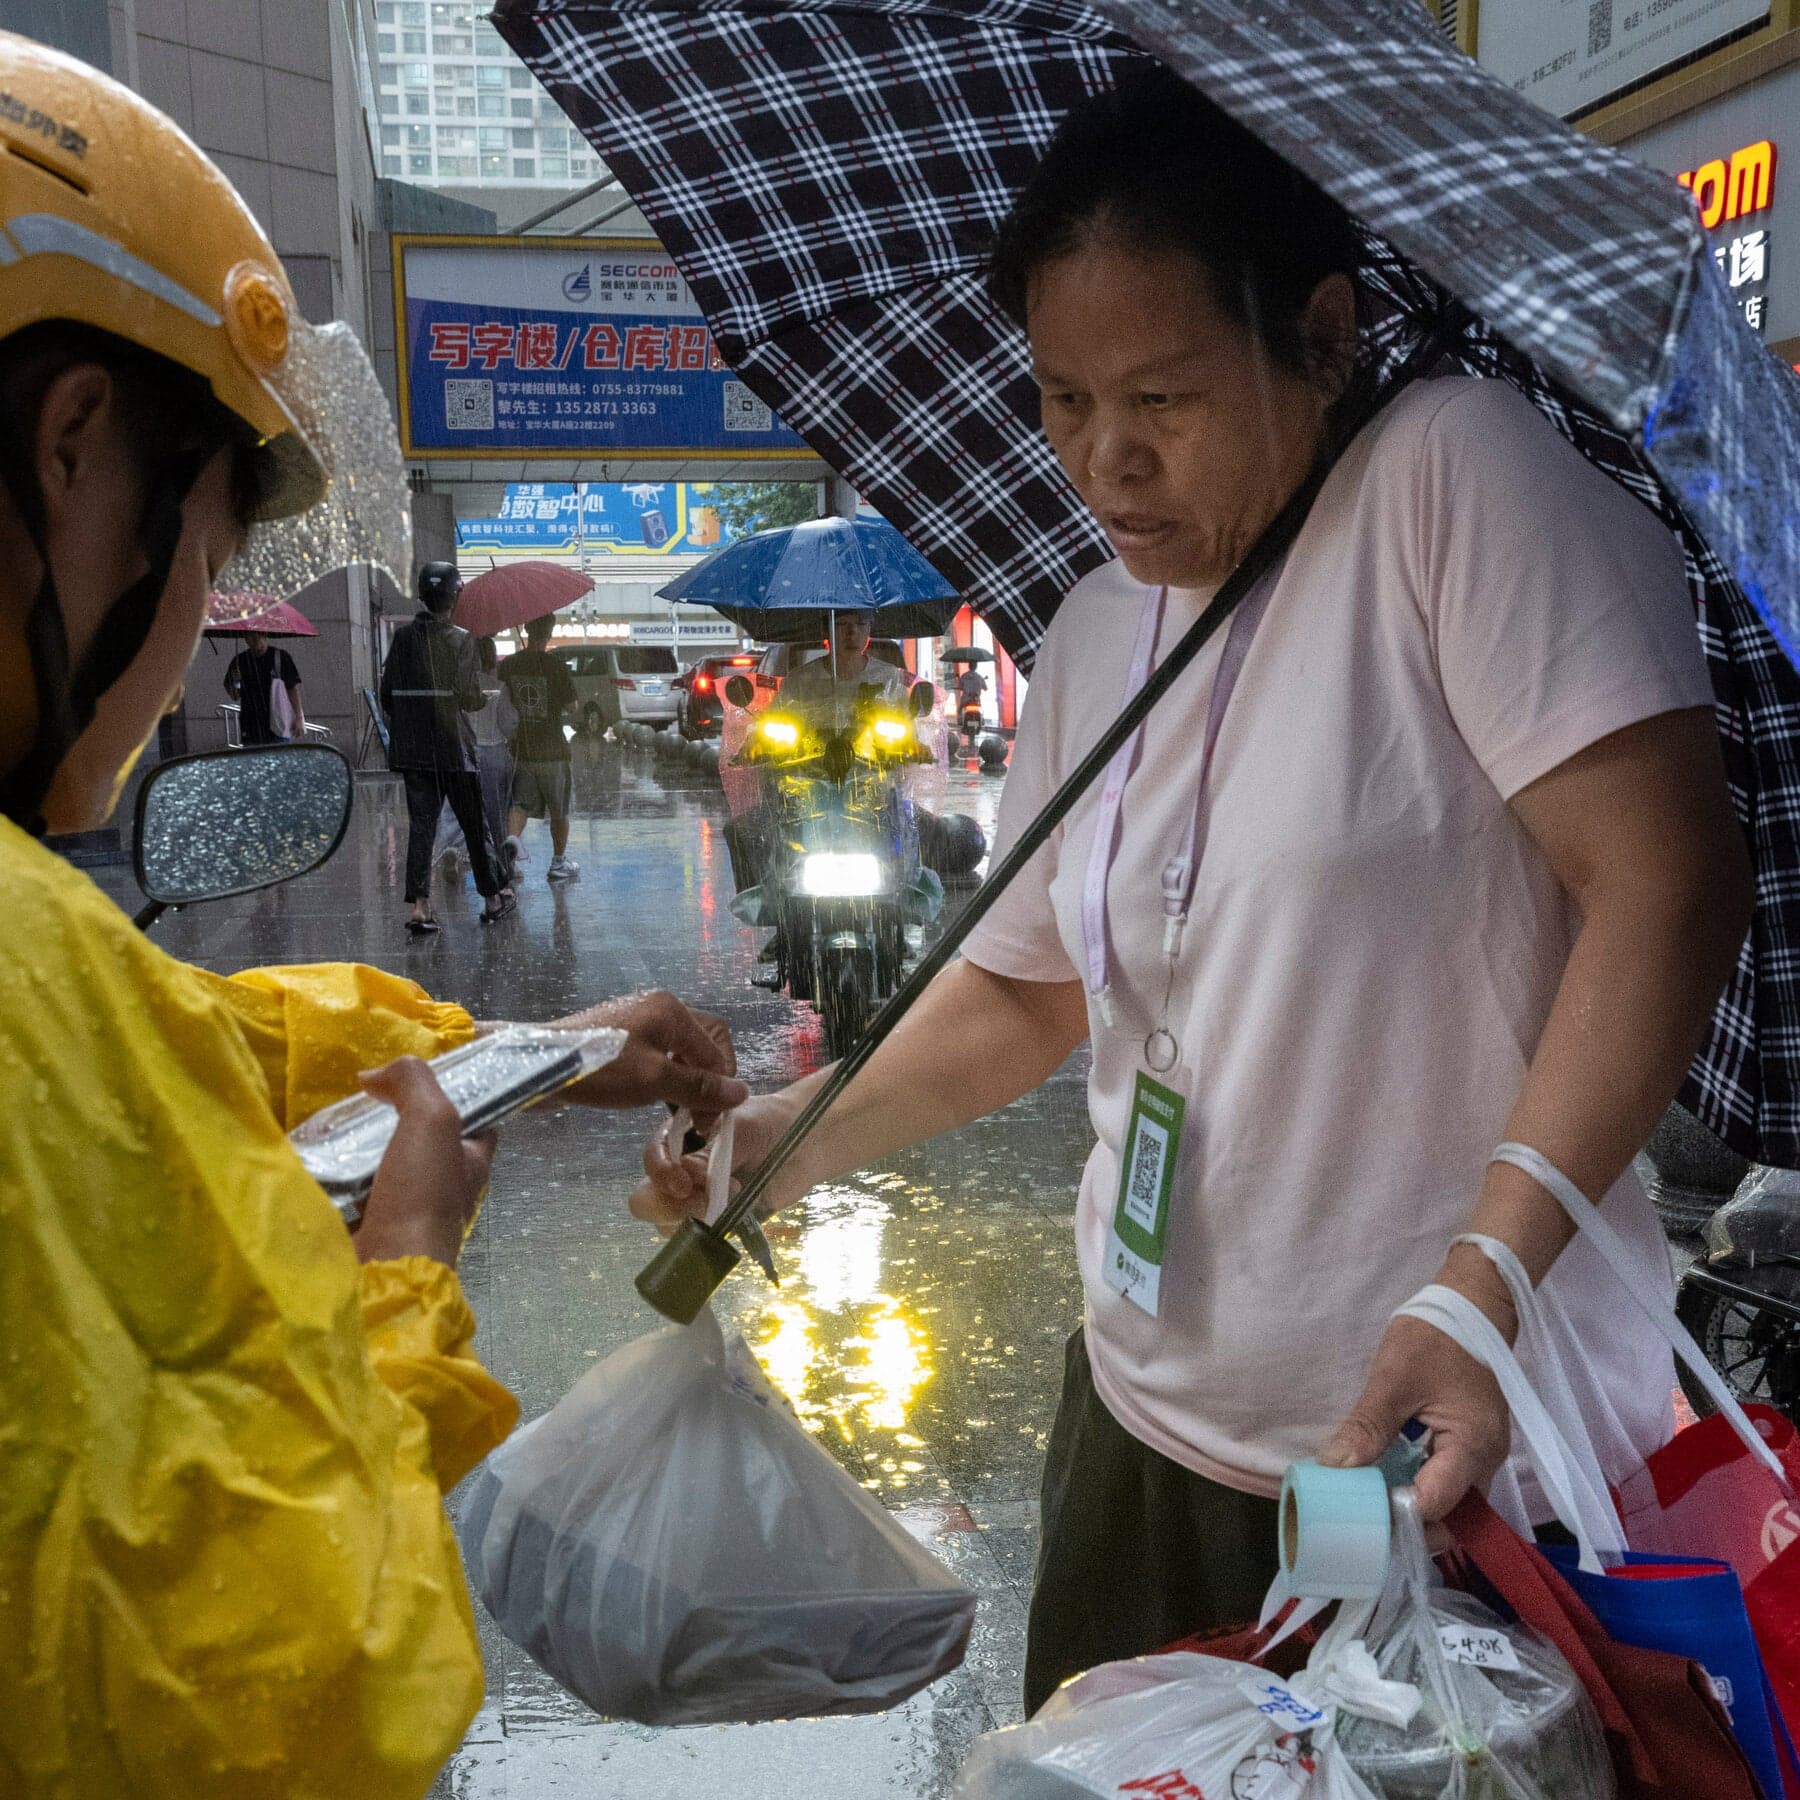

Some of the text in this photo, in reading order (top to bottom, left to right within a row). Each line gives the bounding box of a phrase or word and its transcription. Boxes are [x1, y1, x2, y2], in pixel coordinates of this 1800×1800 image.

[1714, 229, 1766, 287] 场
[600, 280, 678, 291] 赛格通信市场
[601, 292, 678, 302] 宝华大厦
[592, 383, 685, 396] 0755-83779881
[555, 401, 581, 415] 135
[584, 401, 618, 416] 2871
[622, 402, 657, 416] 3363
